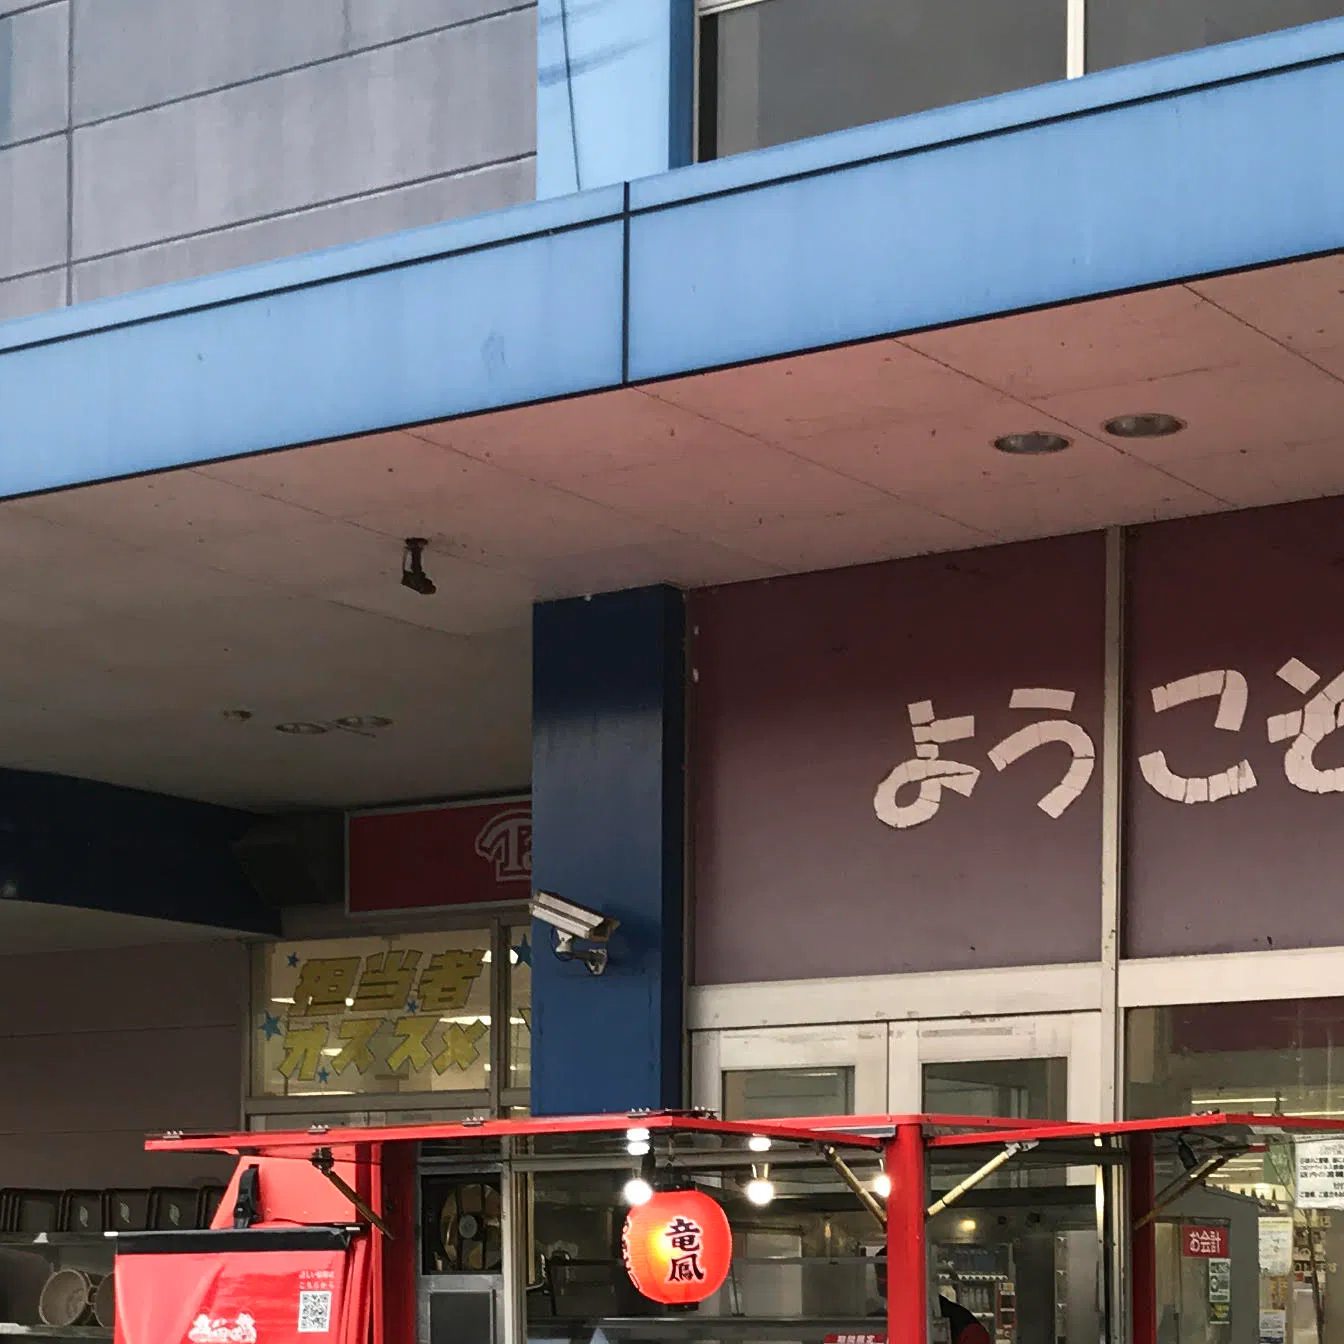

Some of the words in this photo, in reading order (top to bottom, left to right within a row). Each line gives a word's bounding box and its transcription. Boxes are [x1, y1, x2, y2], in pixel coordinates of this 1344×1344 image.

[286, 946, 488, 1020] 担当者
[278, 1013, 490, 1083] オススメ
[664, 1217, 705, 1282] 竜鳳
